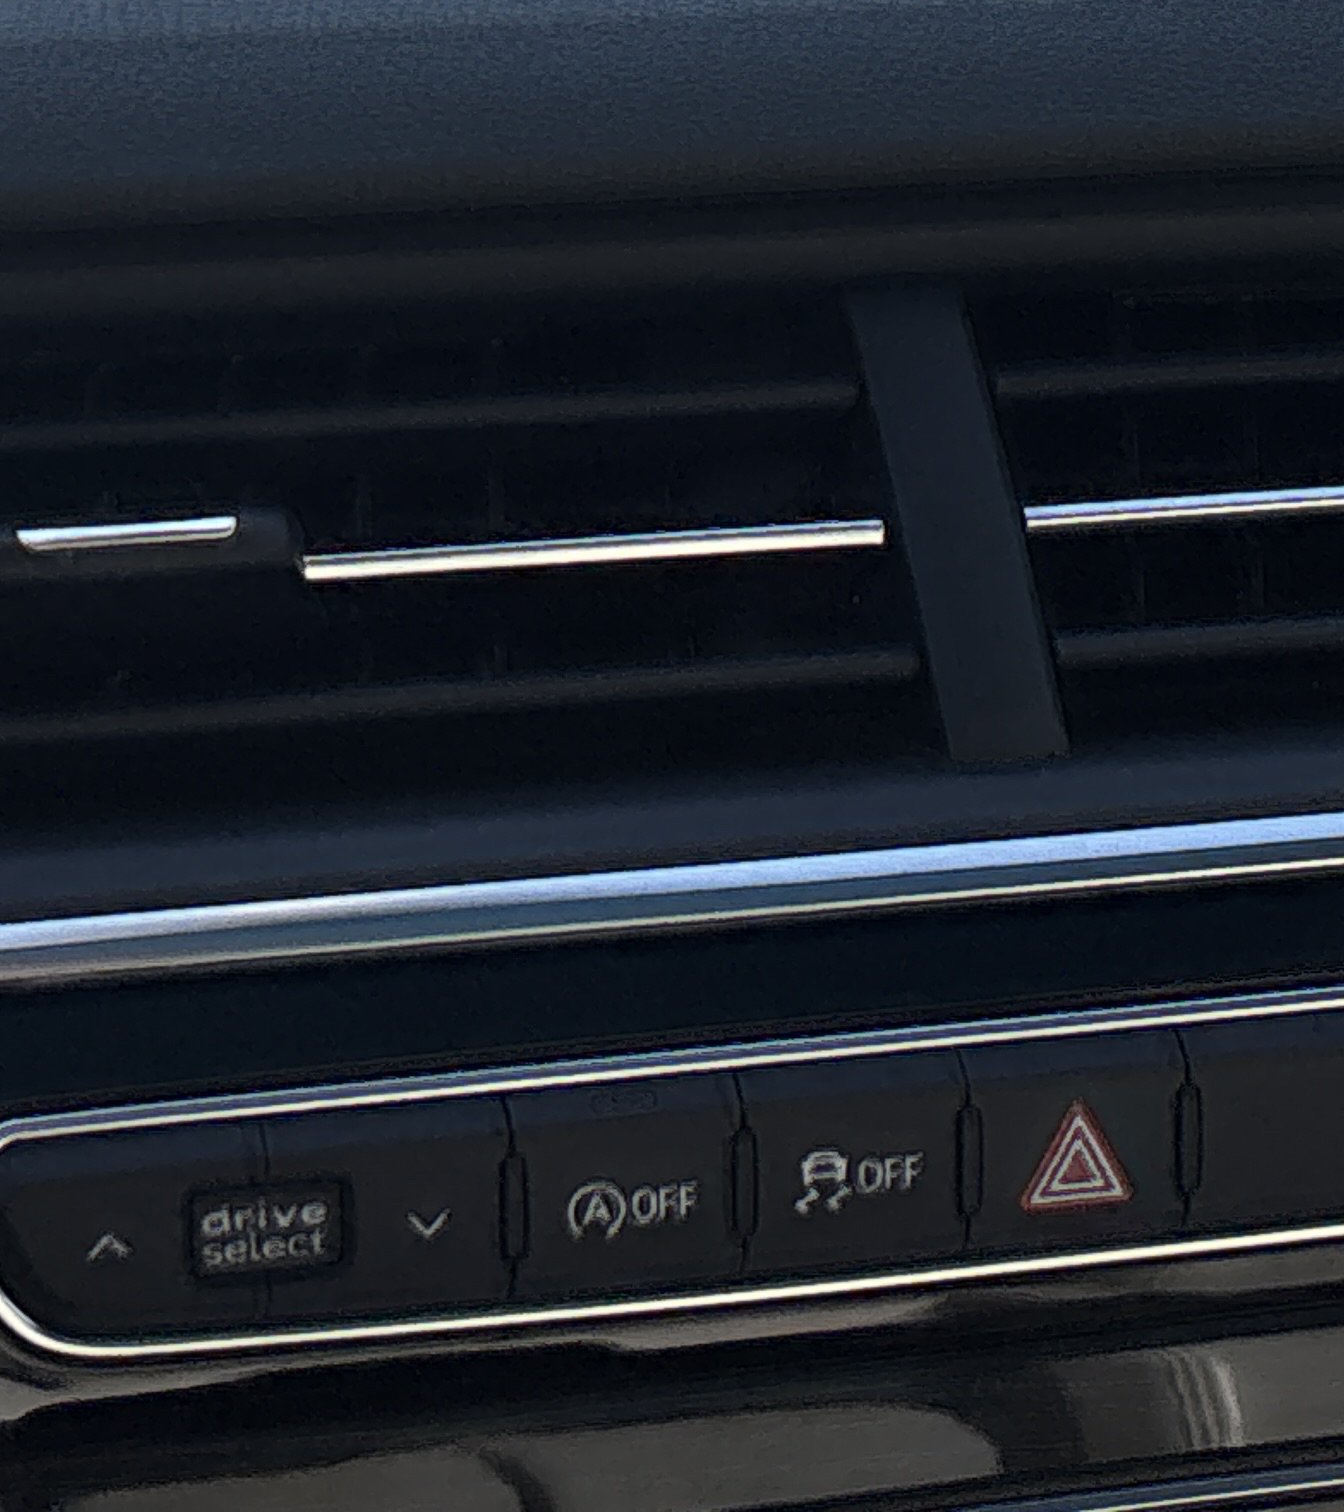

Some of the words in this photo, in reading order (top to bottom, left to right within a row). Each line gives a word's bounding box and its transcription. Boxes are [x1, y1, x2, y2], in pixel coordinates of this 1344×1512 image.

[857, 1152, 924, 1194] OFF
[201, 1199, 328, 1238] drive
[631, 1180, 699, 1226] OFF
[200, 1228, 326, 1267] select
